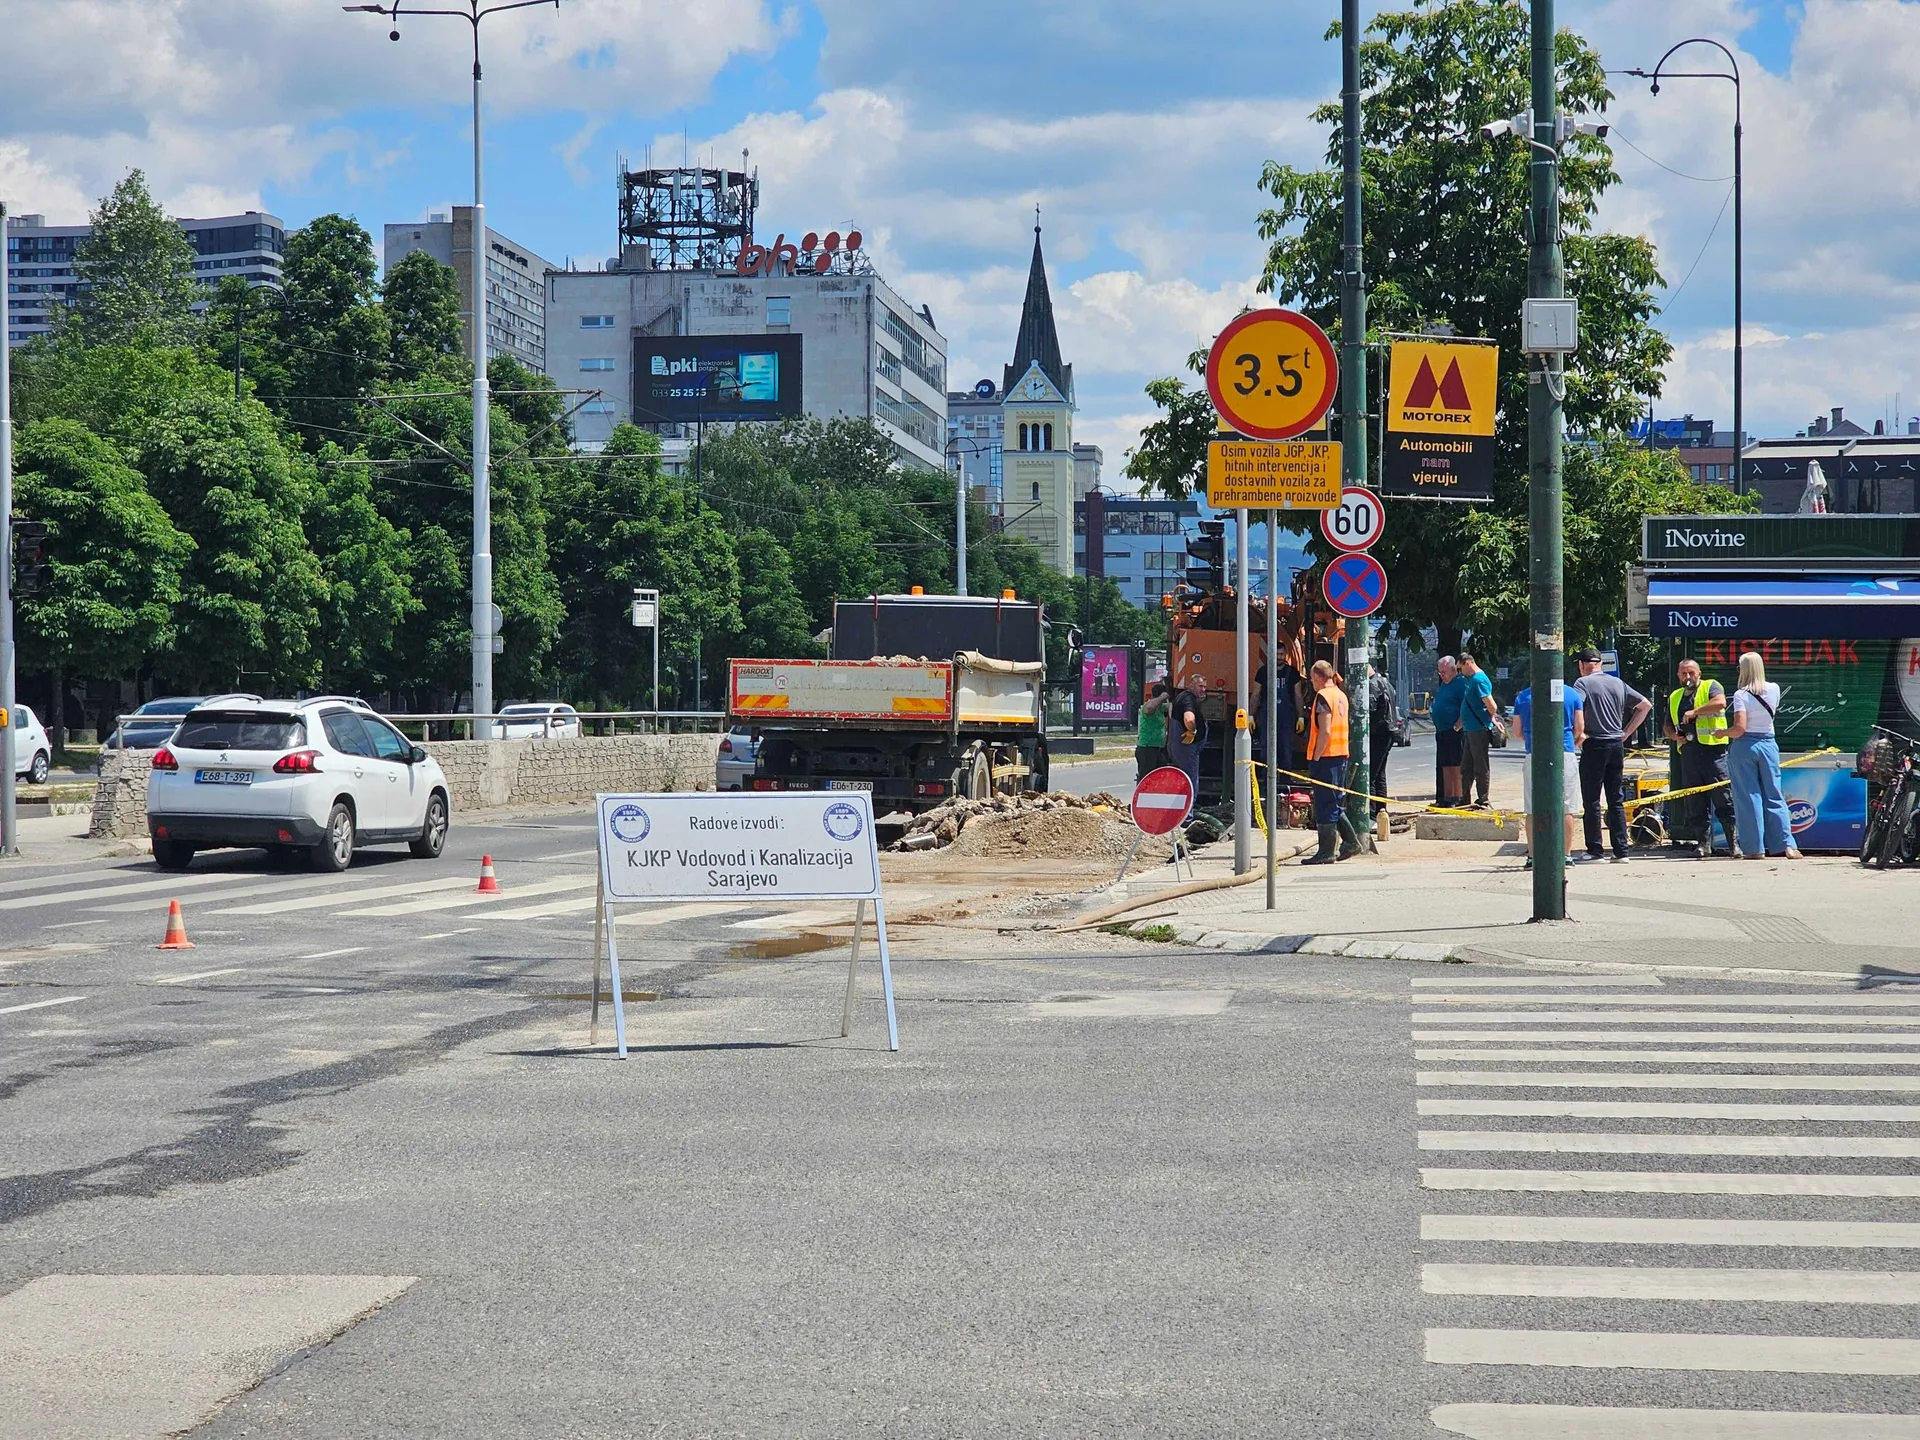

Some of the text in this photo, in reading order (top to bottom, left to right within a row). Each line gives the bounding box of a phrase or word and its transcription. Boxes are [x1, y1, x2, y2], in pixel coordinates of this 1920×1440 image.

[737, 233, 798, 275] bh
[670, 357, 697, 376] pki
[652, 389, 669, 397] 033
[670, 389, 681, 397] 25
[683, 389, 694, 397] 25
[1402, 412, 1471, 423] MOTOREX
[1221, 444, 1246, 457] Osim
[1250, 444, 1280, 457] vozila
[1400, 438, 1473, 453] Automobili
[1225, 460, 1326, 476] hitnih intervencija i
[1421, 457, 1451, 468] nam
[1224, 474, 1326, 488] dostavnih vozila za
[1412, 471, 1458, 487] vjeruju
[1213, 489, 1282, 504] prehrambene
[1335, 504, 1370, 535] 60
[1665, 528, 1745, 548] iNovine
[1667, 611, 1739, 628] iNovine
[1085, 701, 1122, 712] MojSan
[202, 771, 250, 782] E68-T-391
[831, 781, 872, 790] E06-T-230
[1791, 806, 1814, 820] edo
[689, 816, 738, 830] Radove
[627, 848, 853, 870] KJKP Vodovod i Kanalizacija
[708, 870, 778, 891] Sarajevo
